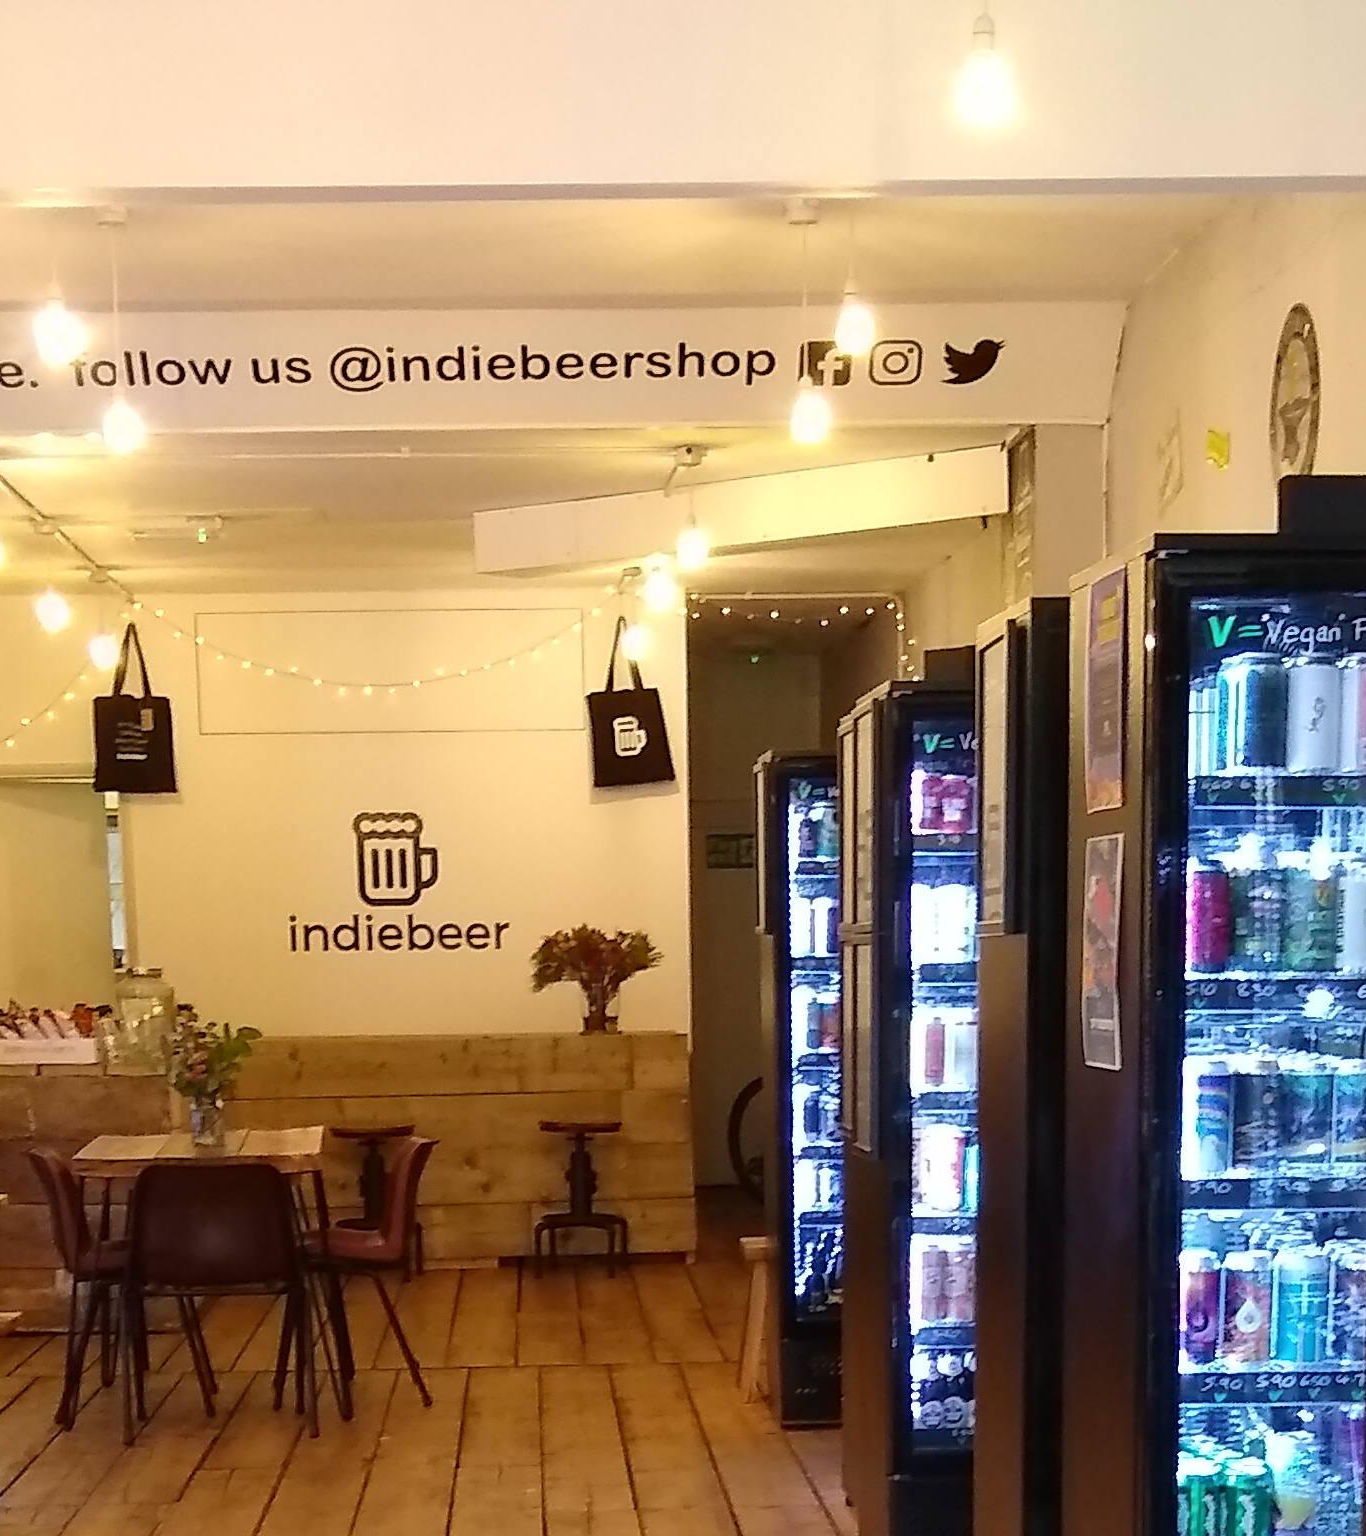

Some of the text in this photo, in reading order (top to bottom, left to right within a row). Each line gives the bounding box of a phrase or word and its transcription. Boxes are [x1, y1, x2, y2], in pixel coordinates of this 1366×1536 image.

[251, 357, 312, 384] us
[329, 342, 776, 393] @indiebeershop
[288, 913, 511, 954] indiebeer
